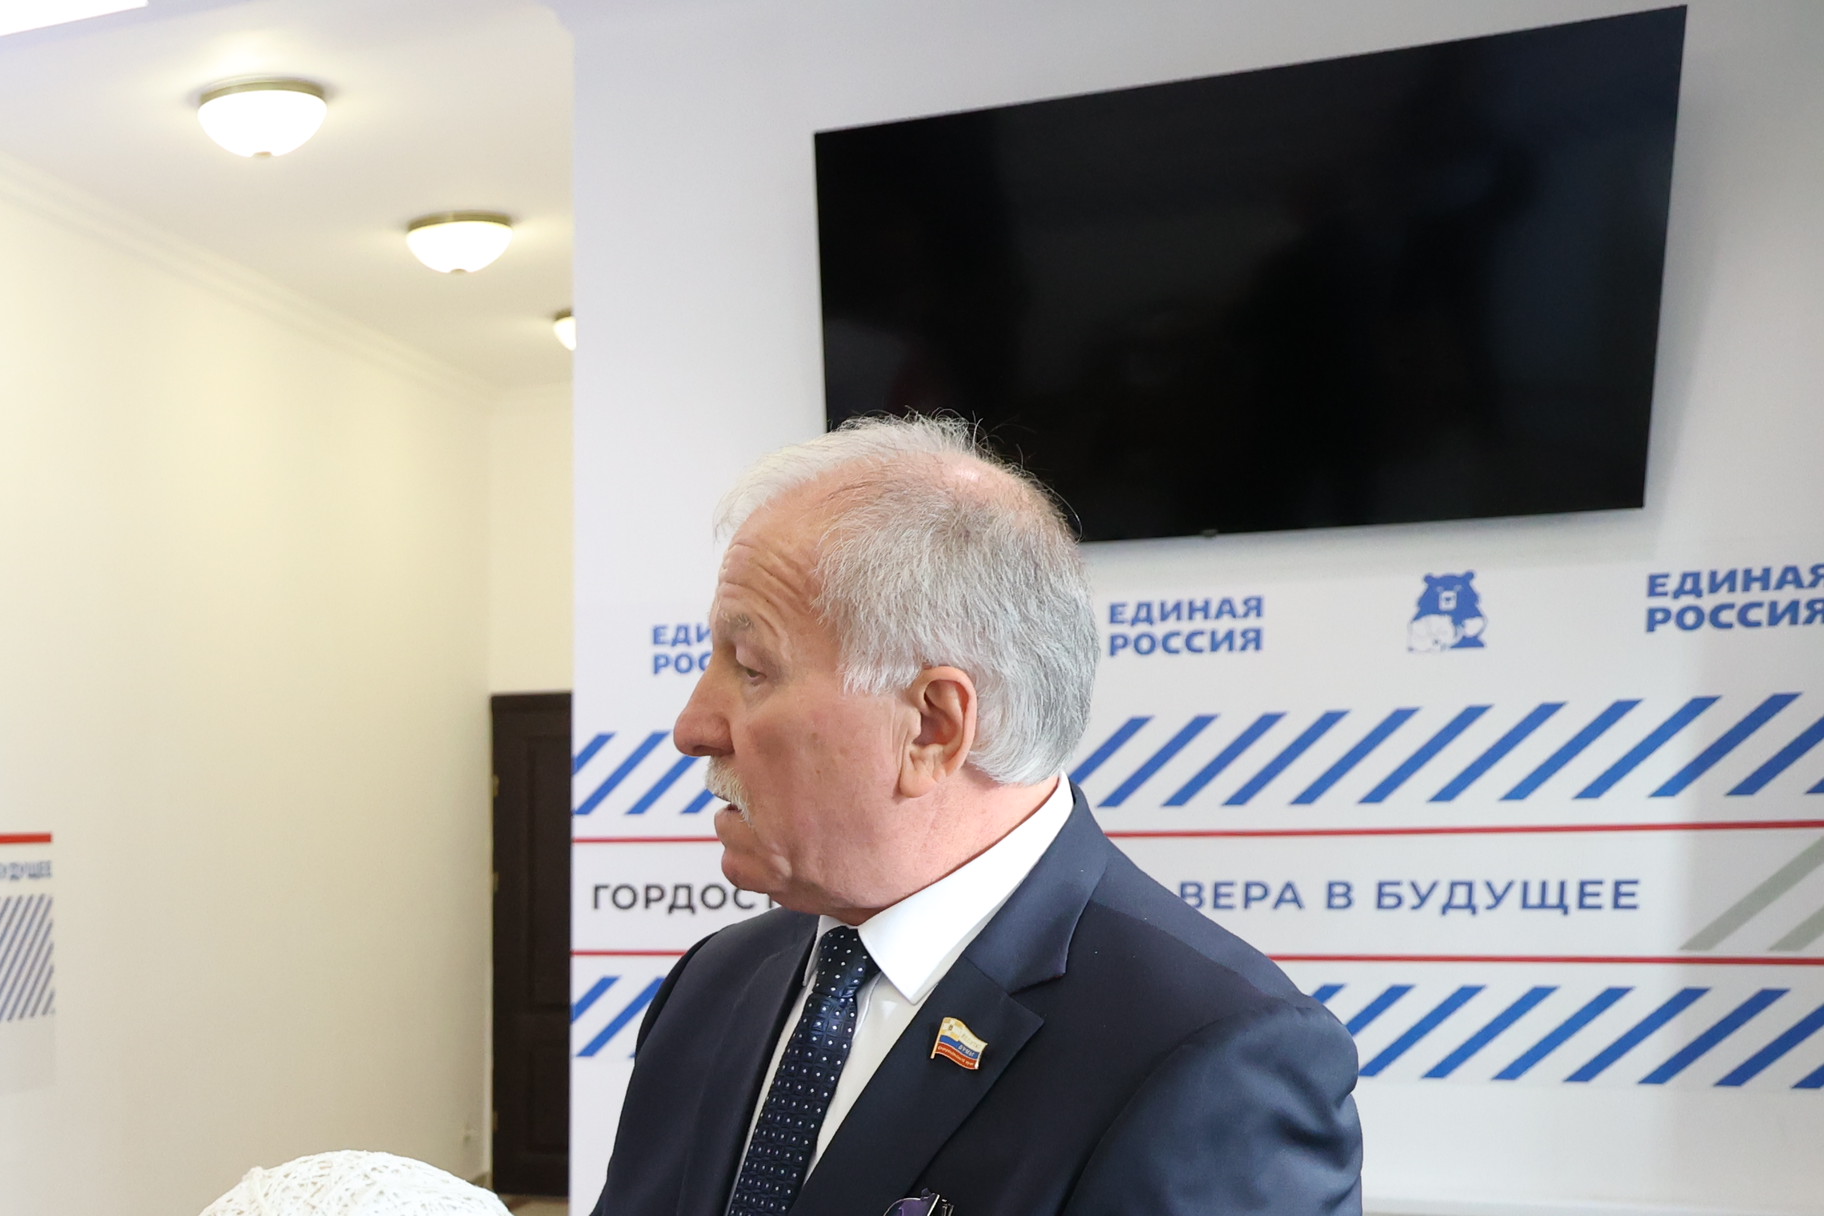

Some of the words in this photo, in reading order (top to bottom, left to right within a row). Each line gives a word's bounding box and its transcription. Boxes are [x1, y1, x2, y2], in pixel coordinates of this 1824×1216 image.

[1647, 563, 1824, 600] ЕДИНАЯ
[1109, 595, 1263, 627] ЕДИНАЯ
[1646, 598, 1824, 633] РОССИЯ
[1109, 628, 1263, 657] РОССИЯ
[593, 884, 773, 915] ГОРДОС
[1179, 880, 1304, 910] ВЕРА
[1327, 880, 1353, 910] В
[1375, 879, 1641, 915] БУДУЩЕЕ
